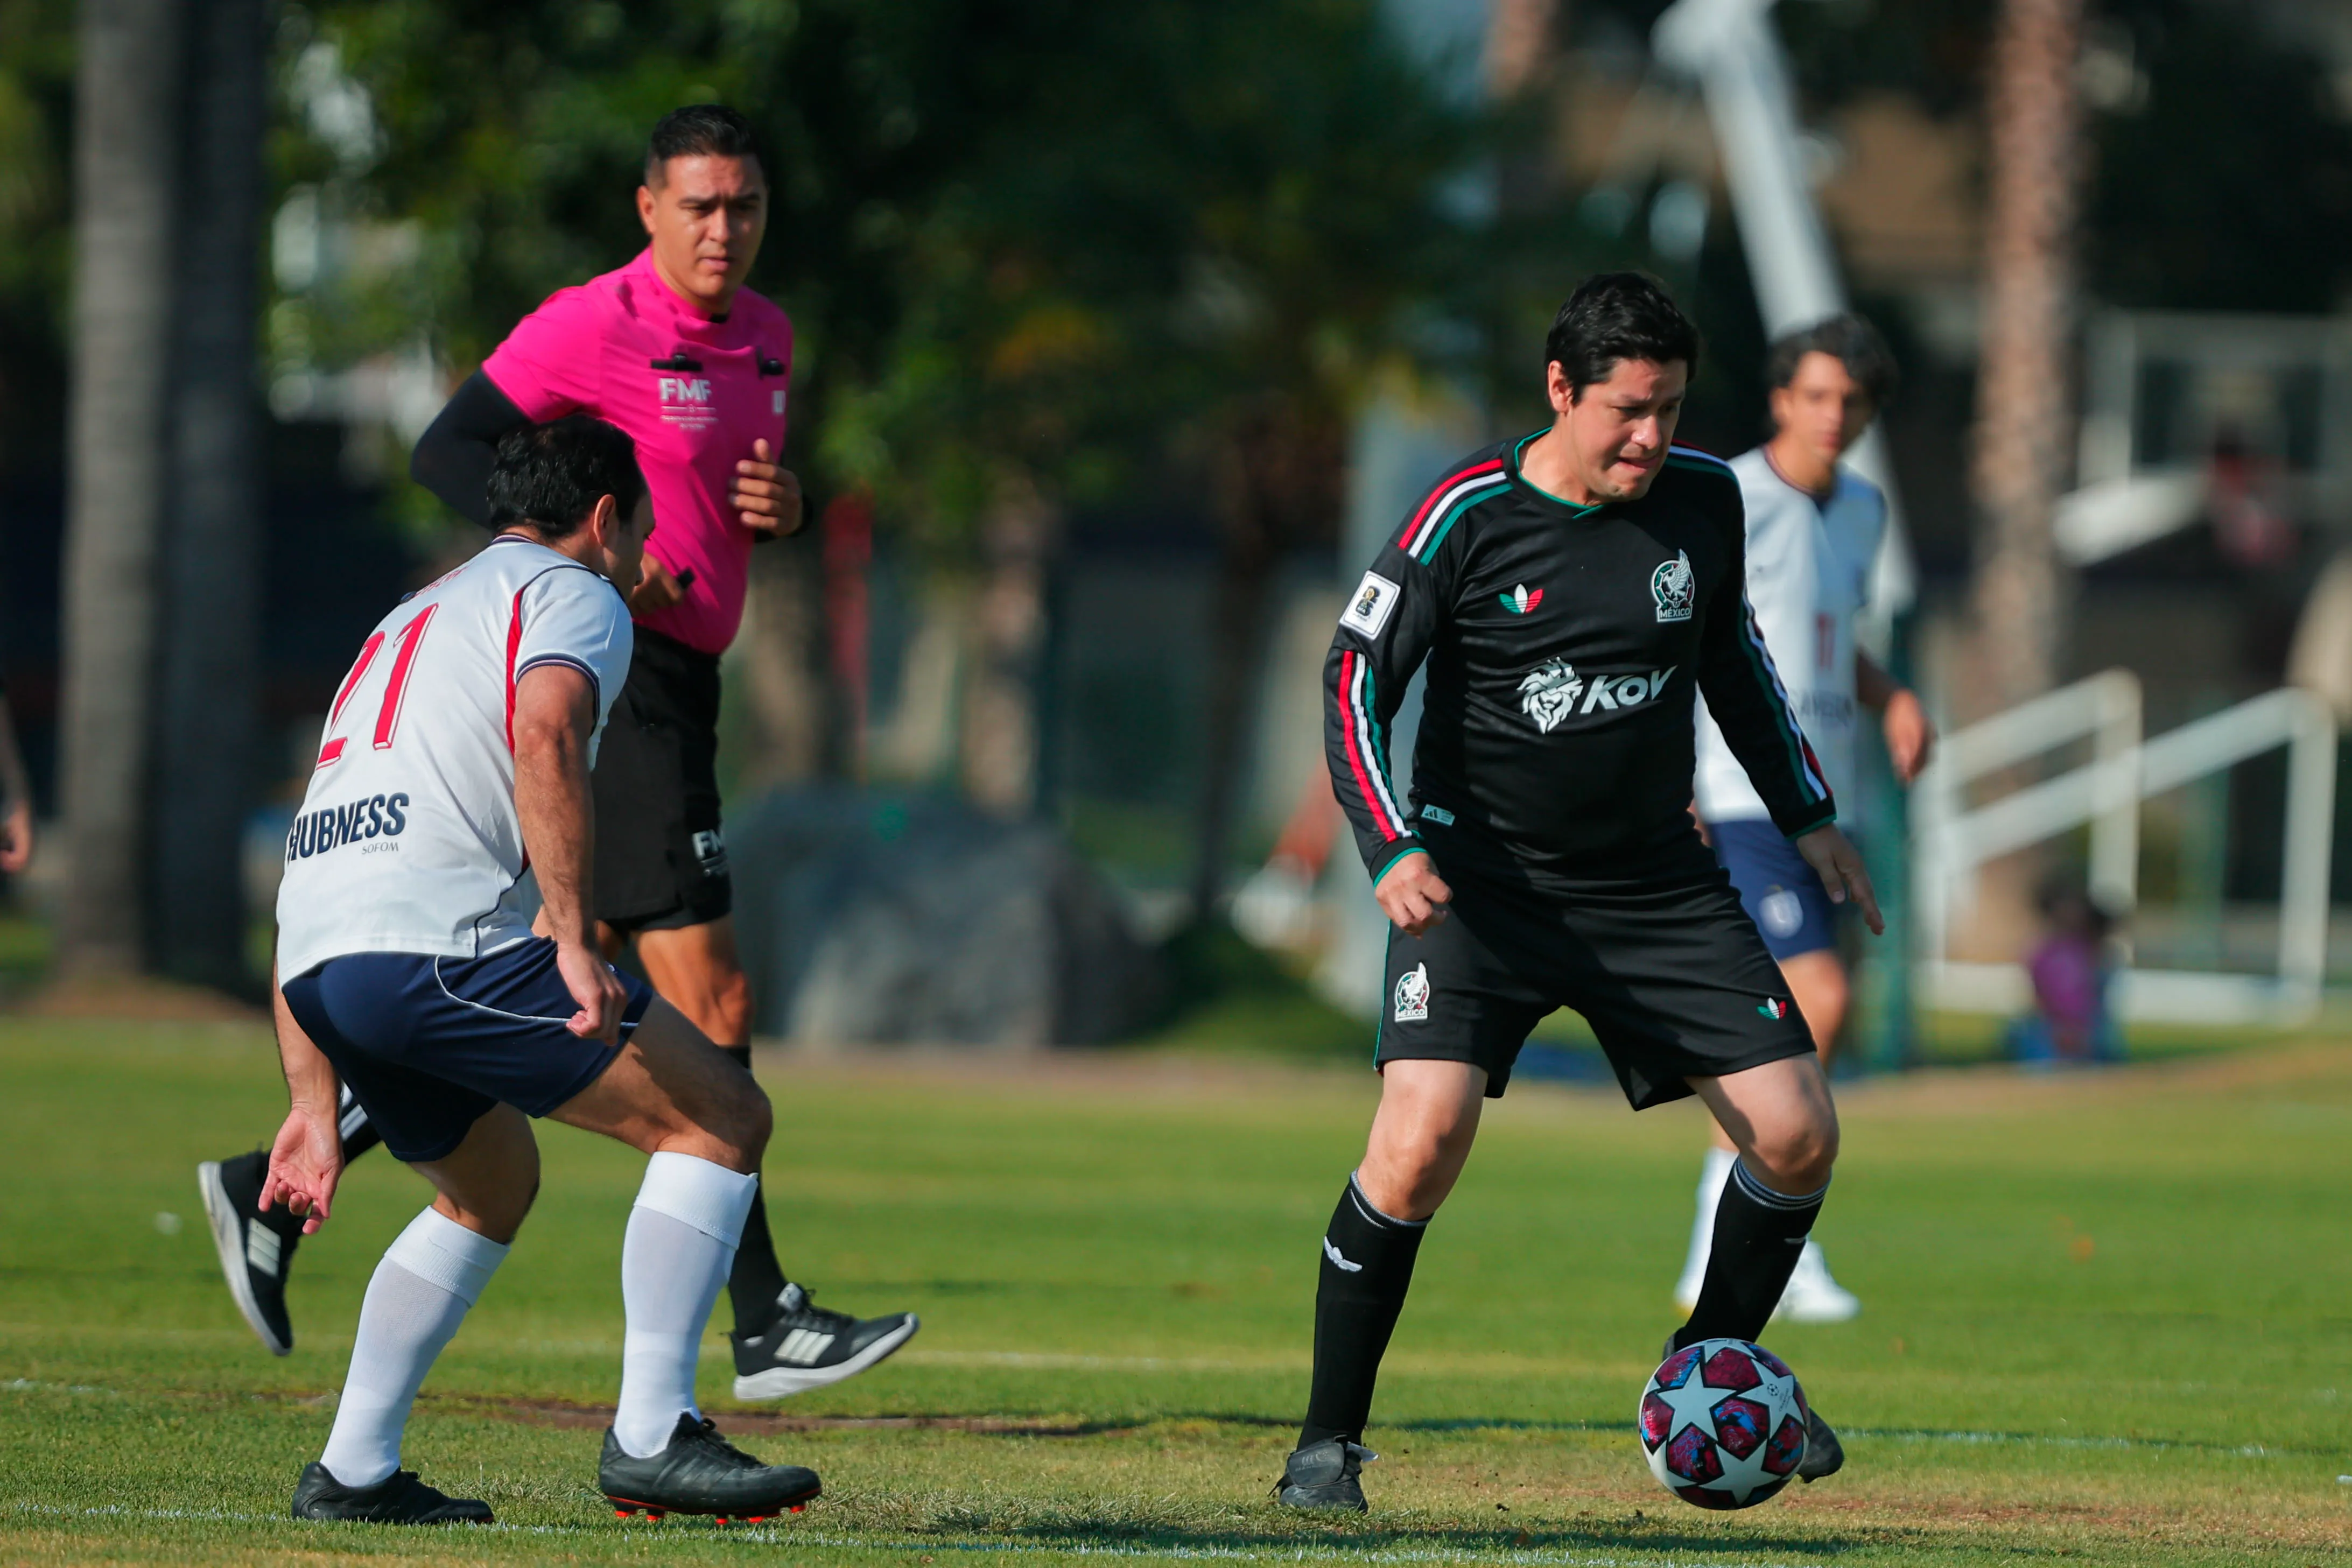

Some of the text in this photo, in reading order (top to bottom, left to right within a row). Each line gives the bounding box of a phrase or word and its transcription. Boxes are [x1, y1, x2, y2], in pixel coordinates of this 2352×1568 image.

[659, 378, 712, 400] FMF
[1660, 607, 1690, 618] MÉXICO
[315, 602, 439, 770] 21
[1580, 665, 1678, 713] KOV
[287, 792, 410, 866] HUBNESS
[361, 841, 399, 855] SOFOM
